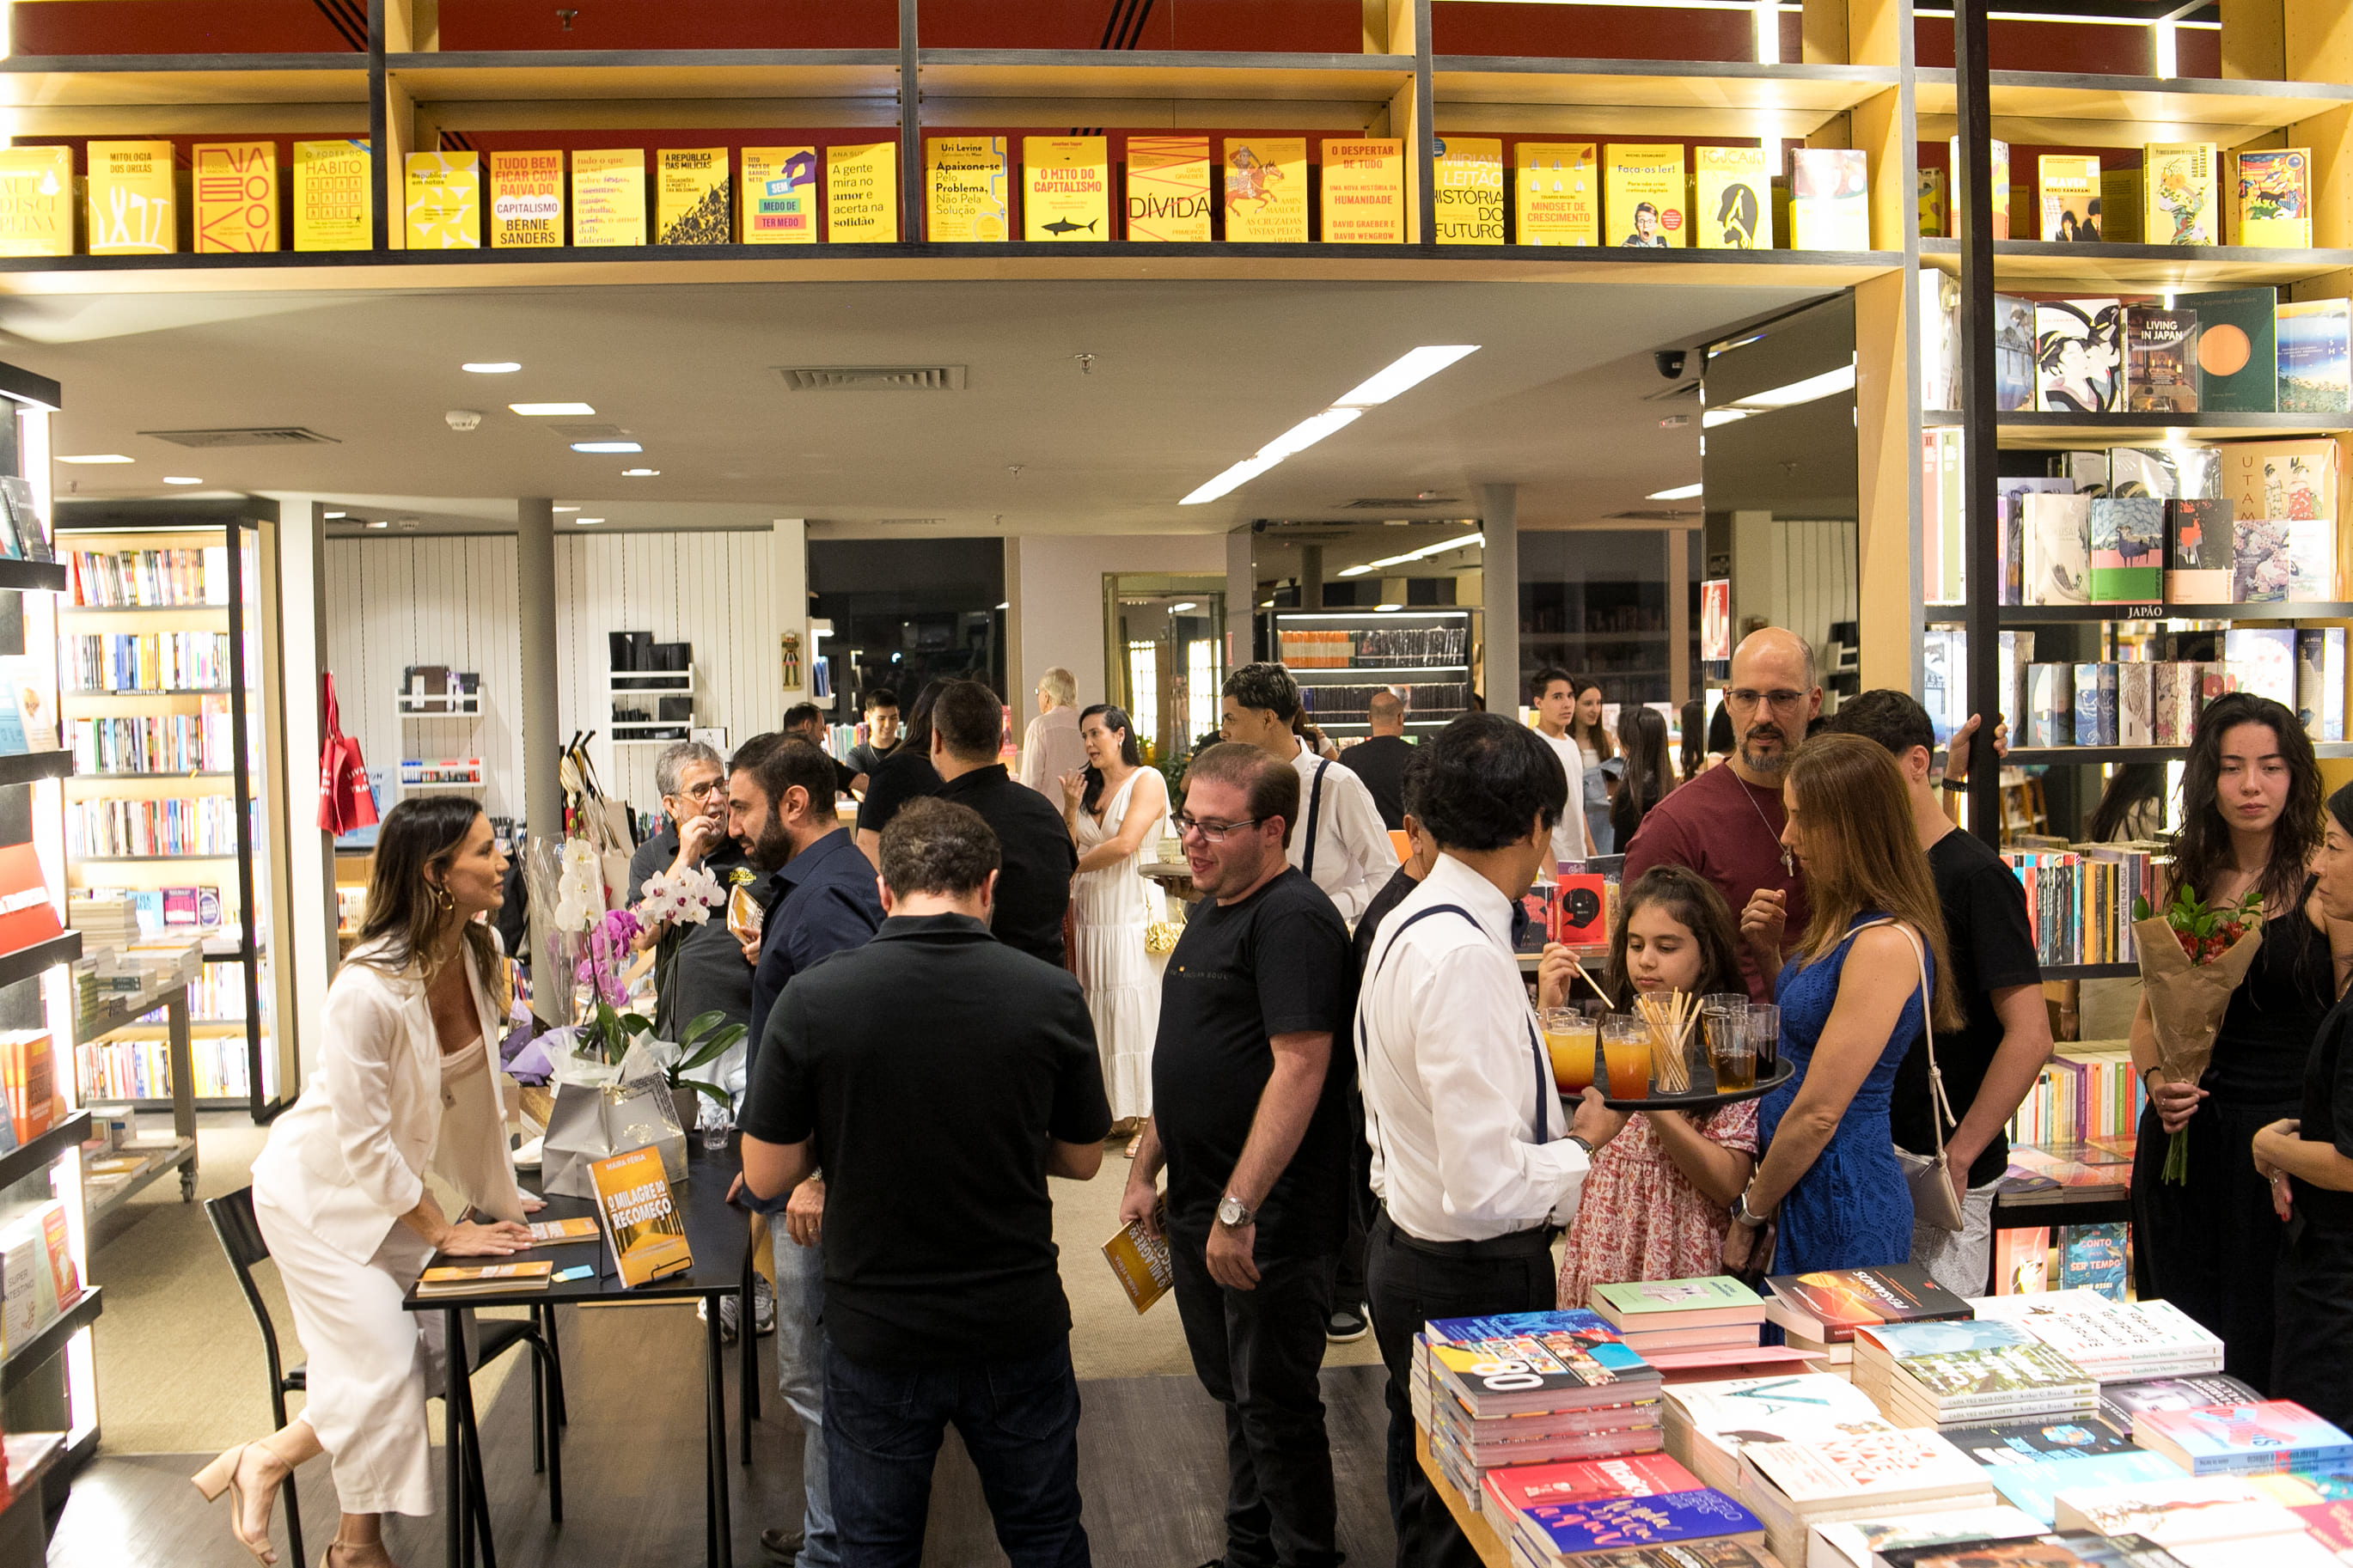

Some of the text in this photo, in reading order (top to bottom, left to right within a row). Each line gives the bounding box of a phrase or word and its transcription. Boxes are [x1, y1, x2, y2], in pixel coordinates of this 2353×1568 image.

[941, 143, 982, 152] Uri Levine
[1332, 145, 1394, 156] O DESPERTAR
[110, 153, 152, 162] MITOLOGIA
[665, 152, 712, 162] A REPÚBLICA
[1442, 149, 1502, 168] MÍRIAM
[1702, 150, 1765, 165] FOUCAULT
[110, 164, 124, 174] DOS
[306, 158, 362, 175] HÁBITO
[497, 157, 557, 170] TUDO BEM
[681, 160, 712, 169] MILÍCIAS
[937, 161, 1000, 174] Apaixone-se
[1343, 159, 1383, 169] DE TUDO
[833, 164, 873, 176] A gente
[1041, 168, 1095, 180] O MITO DO
[1617, 165, 1675, 174] Faça-os ler!
[412, 172, 448, 180] República
[495, 170, 559, 183] FICAR COM
[936, 172, 957, 182] Pelo
[1444, 168, 1503, 187] LEITÃO
[771, 182, 789, 194] SEM
[833, 178, 873, 187] mira no
[1034, 181, 1102, 192] CAPITALISMO
[500, 184, 554, 196] RAIVA DO
[936, 183, 988, 195] Problema,
[833, 192, 864, 201] amor
[936, 194, 981, 204] Não Pela
[1335, 195, 1393, 204] HUMANIDADE
[497, 203, 558, 214] CAPITALISMO
[763, 201, 796, 211] MEDO DE
[834, 204, 883, 214] acerta na
[936, 204, 976, 217] Solução
[1128, 192, 1211, 218] DÍVIDA
[1531, 202, 1586, 211] MINDSET DE
[1478, 207, 1503, 222] DO
[1527, 213, 1590, 222] CRESCIMENTO
[506, 219, 550, 231] BERNIE
[761, 217, 798, 228] TER MEDO
[834, 217, 875, 228] solidão
[578, 226, 598, 235] dolly
[1435, 223, 1503, 238] FUTURO
[500, 232, 556, 244] SANDERS
[2146, 320, 2179, 330] LIVING
[2141, 330, 2184, 340] IN JAPAN
[2127, 603, 2163, 619] JAPÃO
[607, 1180, 667, 1211] O MILAGRE DO
[611, 1198, 672, 1229] RECOMEÇO
[2080, 1238, 2112, 1248] CONTO
[1134, 1234, 1165, 1282] MILAGRE
[2069, 1259, 2121, 1272] SER TEMPO
[8, 1268, 28, 1288] SUPER
[4, 1278, 34, 1303] NTESTINO
